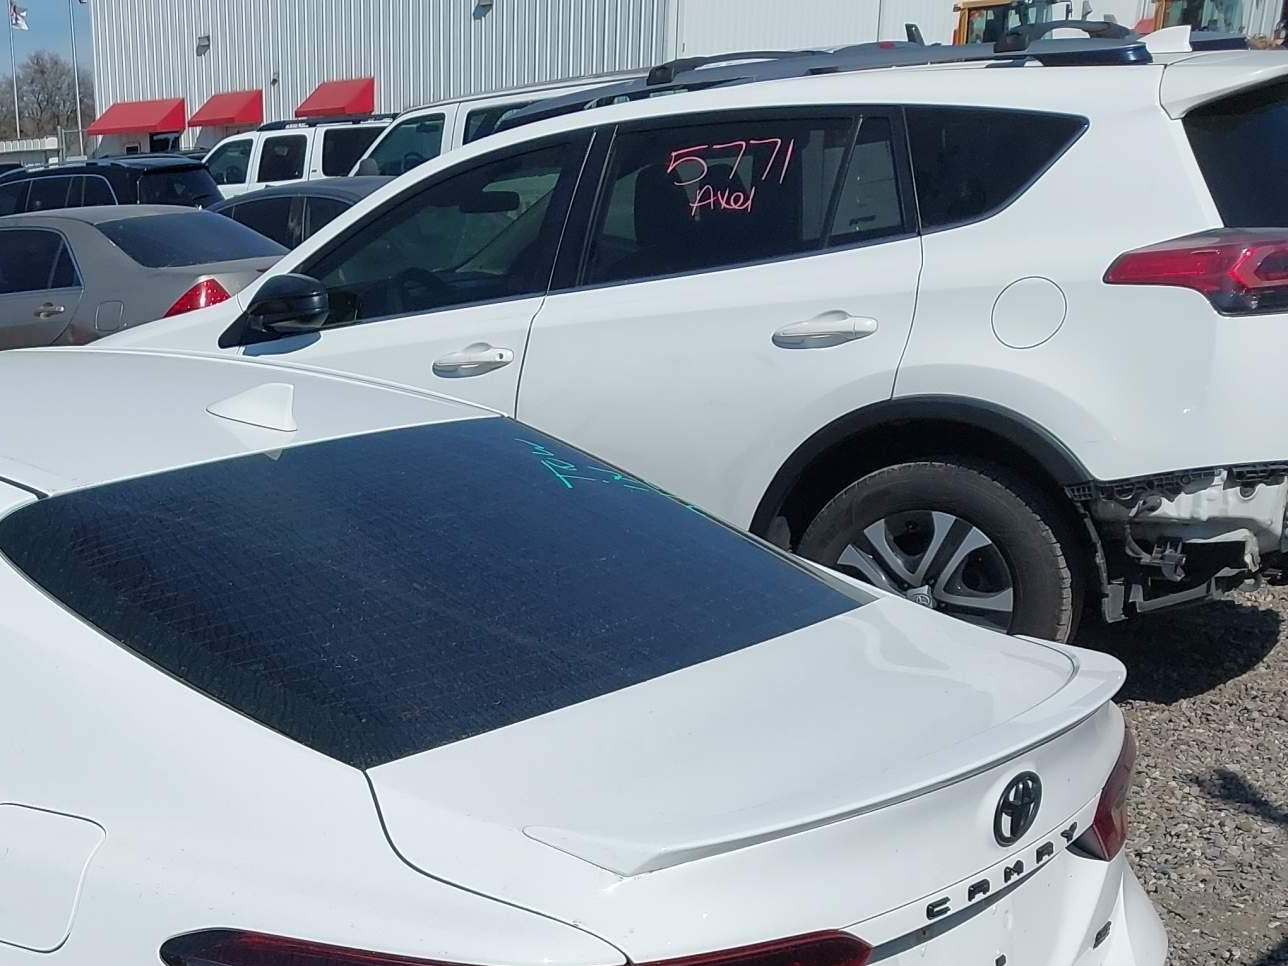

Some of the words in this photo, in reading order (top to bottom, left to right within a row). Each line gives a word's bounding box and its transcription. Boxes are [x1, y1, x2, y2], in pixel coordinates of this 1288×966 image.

[666, 138, 795, 186] 5771
[688, 184, 756, 217] Axel
[925, 821, 1078, 921] CAMRY
